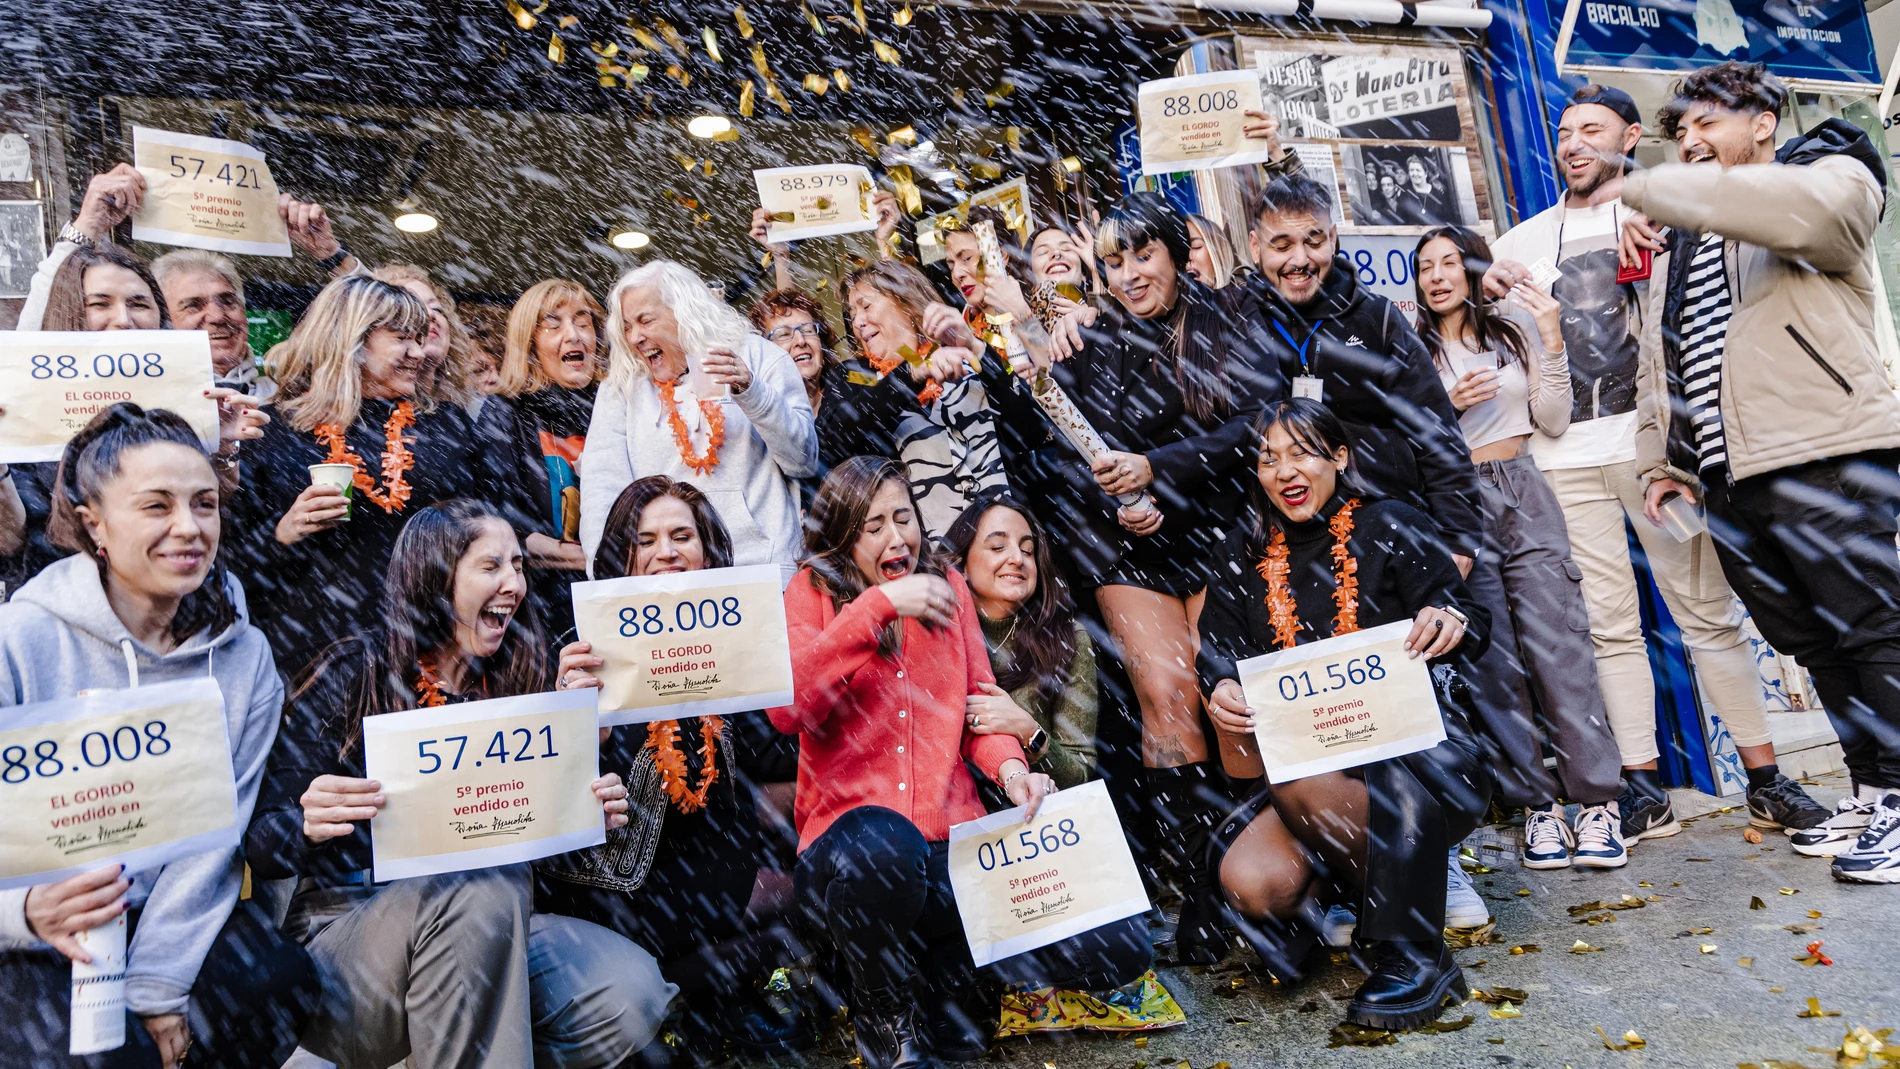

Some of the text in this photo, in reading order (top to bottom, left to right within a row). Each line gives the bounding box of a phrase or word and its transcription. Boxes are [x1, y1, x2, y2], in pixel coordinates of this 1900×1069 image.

[1586, 2, 1660, 28] BACALAO
[1797, 5, 1811, 18] DE
[1776, 25, 1842, 43] IMPORTACION
[1266, 66, 1318, 87] DESDE
[1164, 89, 1239, 117] 88.008
[1280, 100, 1317, 120] 1904
[1333, 82, 1456, 123] LOTERIA
[1181, 131, 1210, 141] vendido
[1182, 120, 1220, 132] EL GORDO
[170, 155, 261, 190] 57.421
[780, 174, 848, 192] 88.979
[194, 192, 242, 207] 5º premio
[190, 203, 244, 217] vendido en
[31, 352, 165, 380] 88.008
[65, 391, 132, 401] EL GORDO
[618, 596, 742, 638] 88.008
[651, 643, 712, 660] EL GORDO
[650, 660, 716, 676] vendido en
[1278, 654, 1387, 702] 01.568
[1312, 698, 1364, 718] 5º premio
[1313, 711, 1371, 731] vendido en
[1, 720, 171, 784] 88.008
[418, 724, 559, 774] 57.421
[51, 780, 135, 810] EL GORDO
[456, 779, 525, 799] 5º premio
[50, 800, 140, 829] vendido en
[453, 796, 530, 816] vendido en
[978, 818, 1081, 872] 01.568
[1009, 867, 1059, 890] 5º premio
[1010, 880, 1067, 905] vendido en
